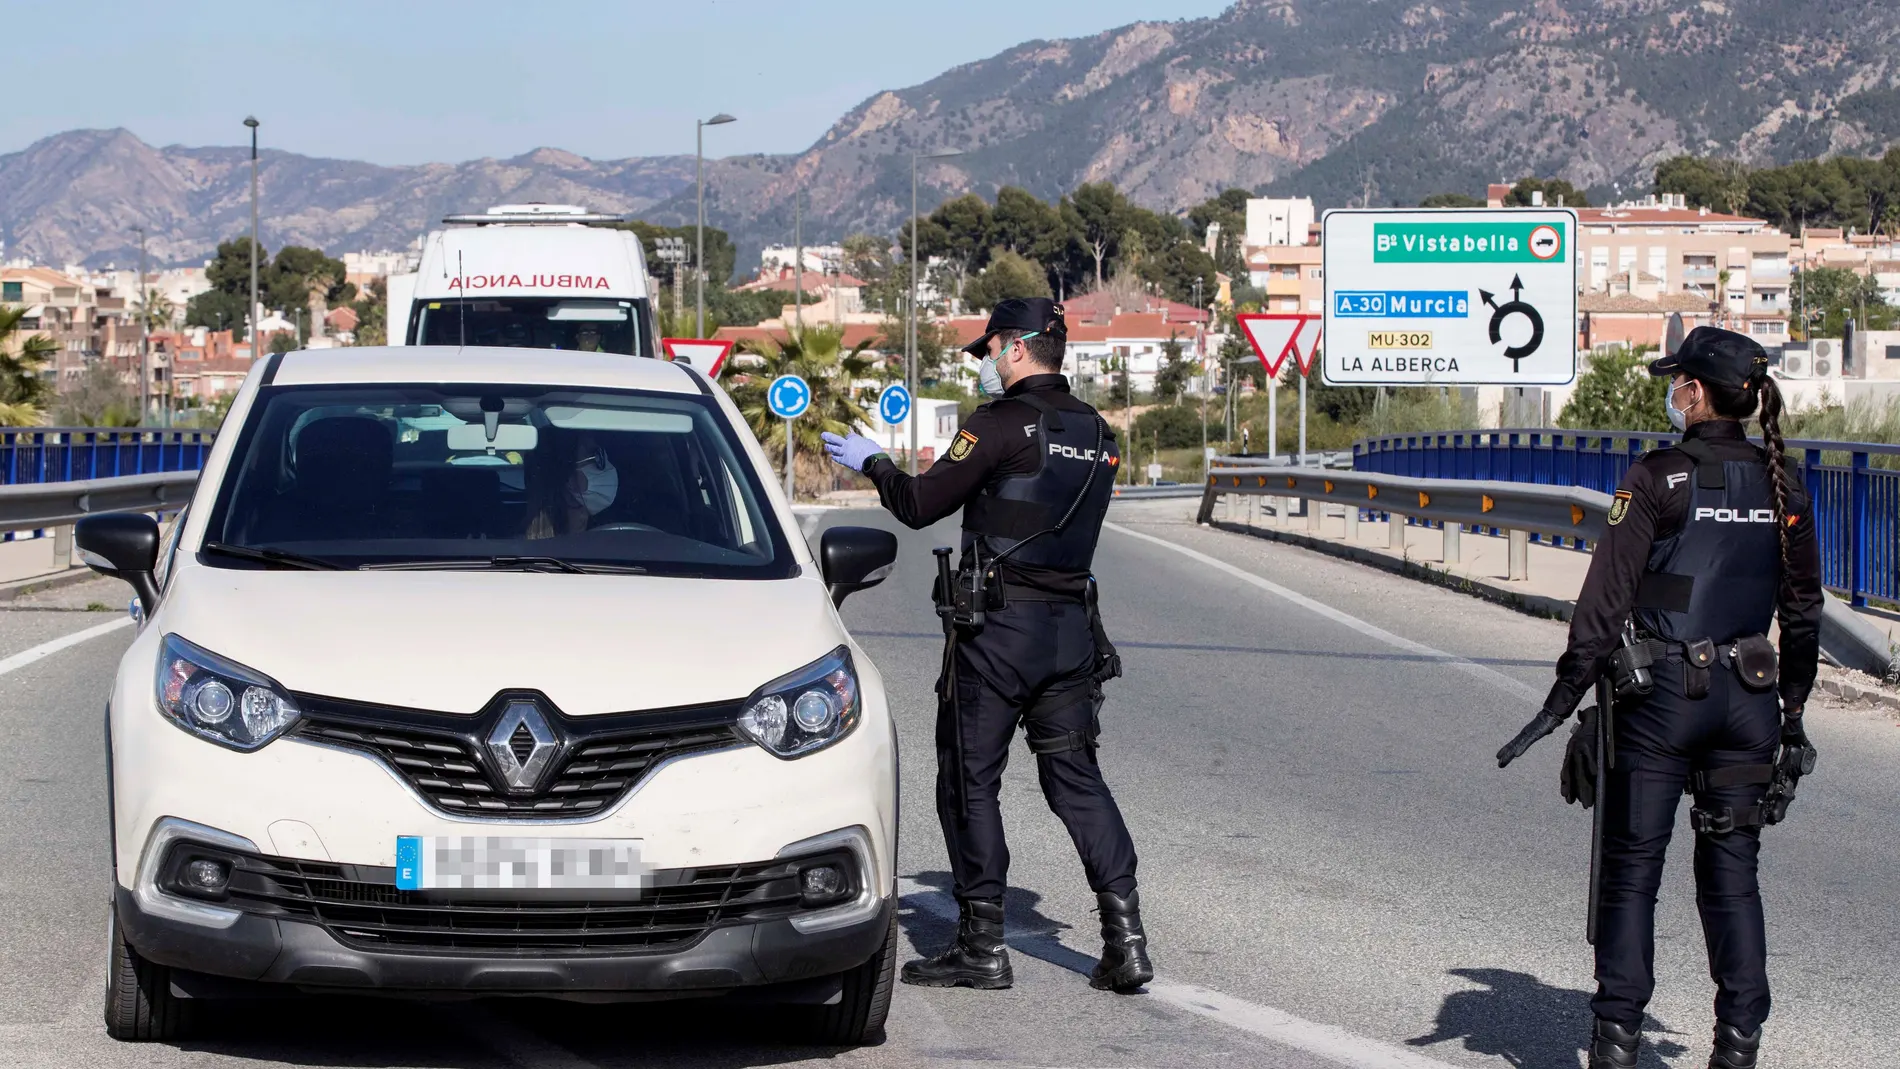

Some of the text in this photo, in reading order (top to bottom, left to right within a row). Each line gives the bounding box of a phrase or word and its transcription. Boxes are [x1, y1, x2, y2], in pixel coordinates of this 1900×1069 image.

[1402, 234, 1519, 252] Vistabella
[1339, 296, 1468, 313] A-30 Murcia
[1371, 334, 1430, 346] MU-302
[1342, 357, 1460, 372] LA ALBERCA
[1048, 443, 1111, 463] POLICA
[1694, 507, 1779, 523] POLICI
[402, 867, 412, 880] E
